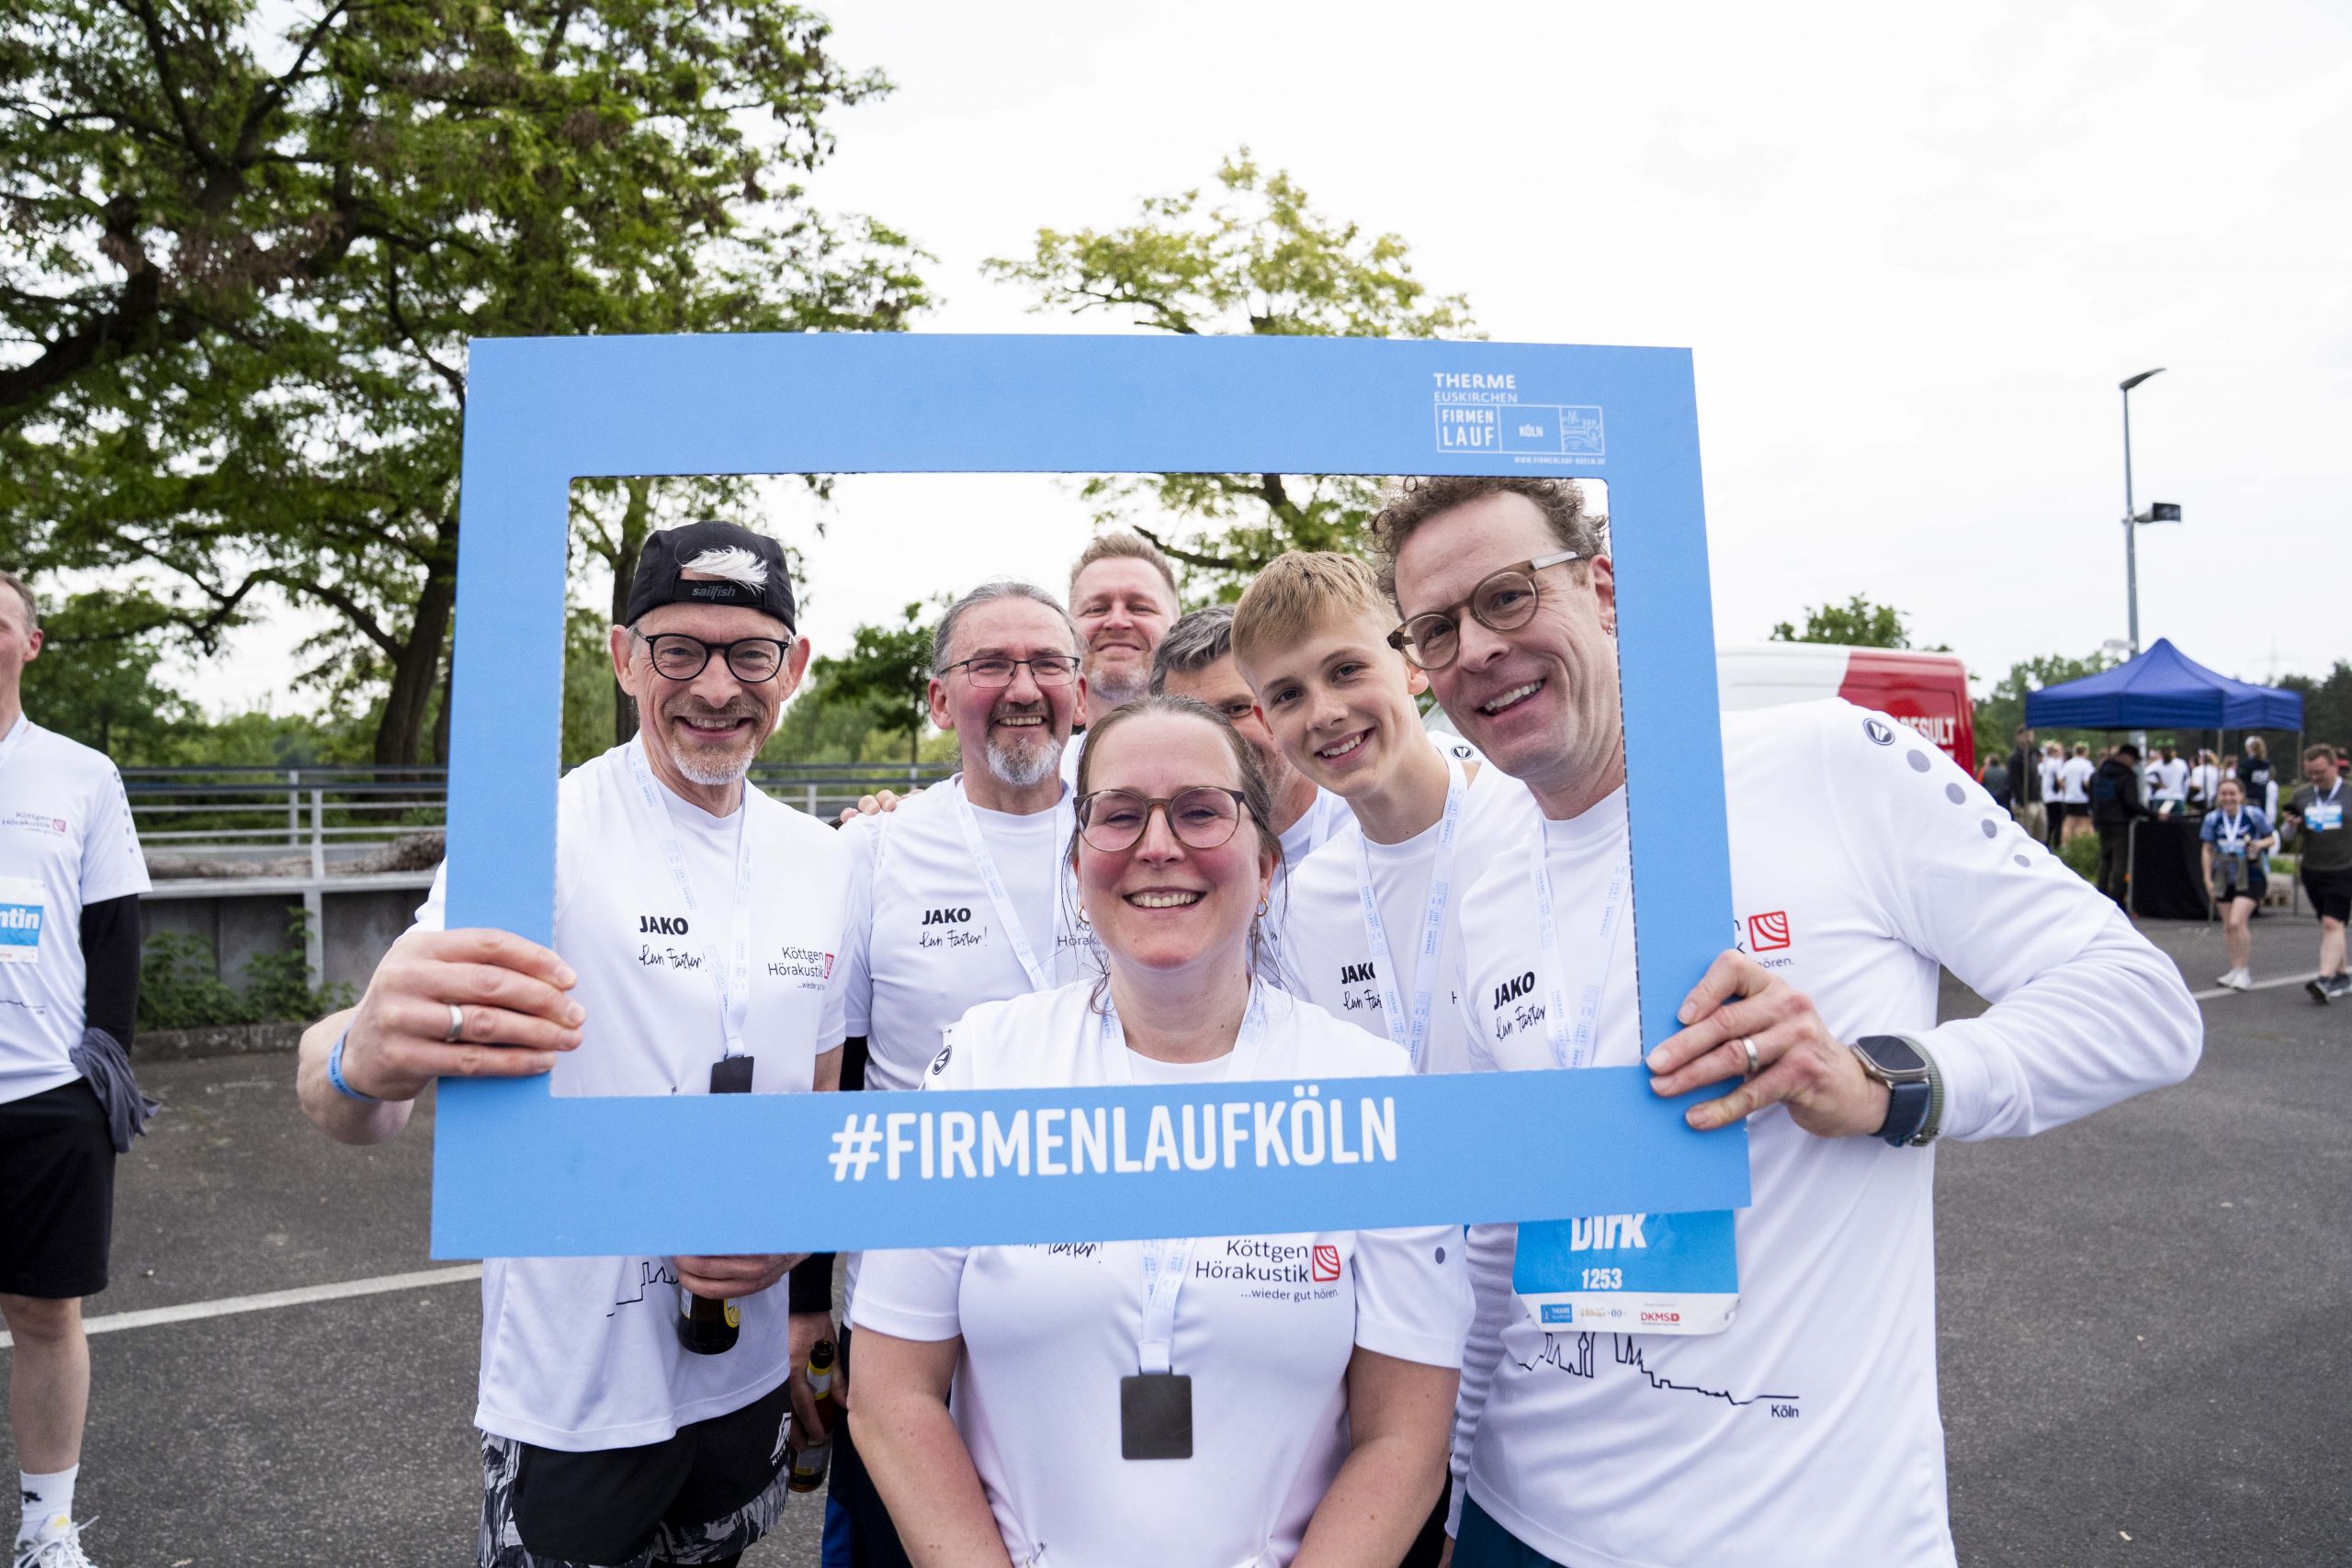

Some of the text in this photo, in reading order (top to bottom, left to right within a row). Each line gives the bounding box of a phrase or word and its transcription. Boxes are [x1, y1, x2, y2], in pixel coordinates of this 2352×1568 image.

[1433, 373, 1516, 389] THERME
[1434, 391, 1517, 403] EUSKIRCHEN
[1442, 409, 1494, 423] FIRMEN
[1443, 426, 1494, 446] LAUF
[1519, 423, 1544, 437] KÖLN
[692, 585, 736, 600] sailfish
[639, 915, 689, 935] JAKO
[922, 908, 971, 925] JAKO
[782, 946, 824, 964] Köttgen
[767, 963, 824, 978] Hörakustik
[1494, 971, 1535, 1010] JAKO
[828, 1084, 1396, 1182] #FIRMENLAUFKÖLN
[1227, 1239, 1308, 1263] Köttgen
[1195, 1260, 1309, 1283] Hörakustik
[1581, 1268, 1623, 1290] 1253
[1294, 1291, 1312, 1303] gut
[1771, 1404, 1799, 1418] Köln
